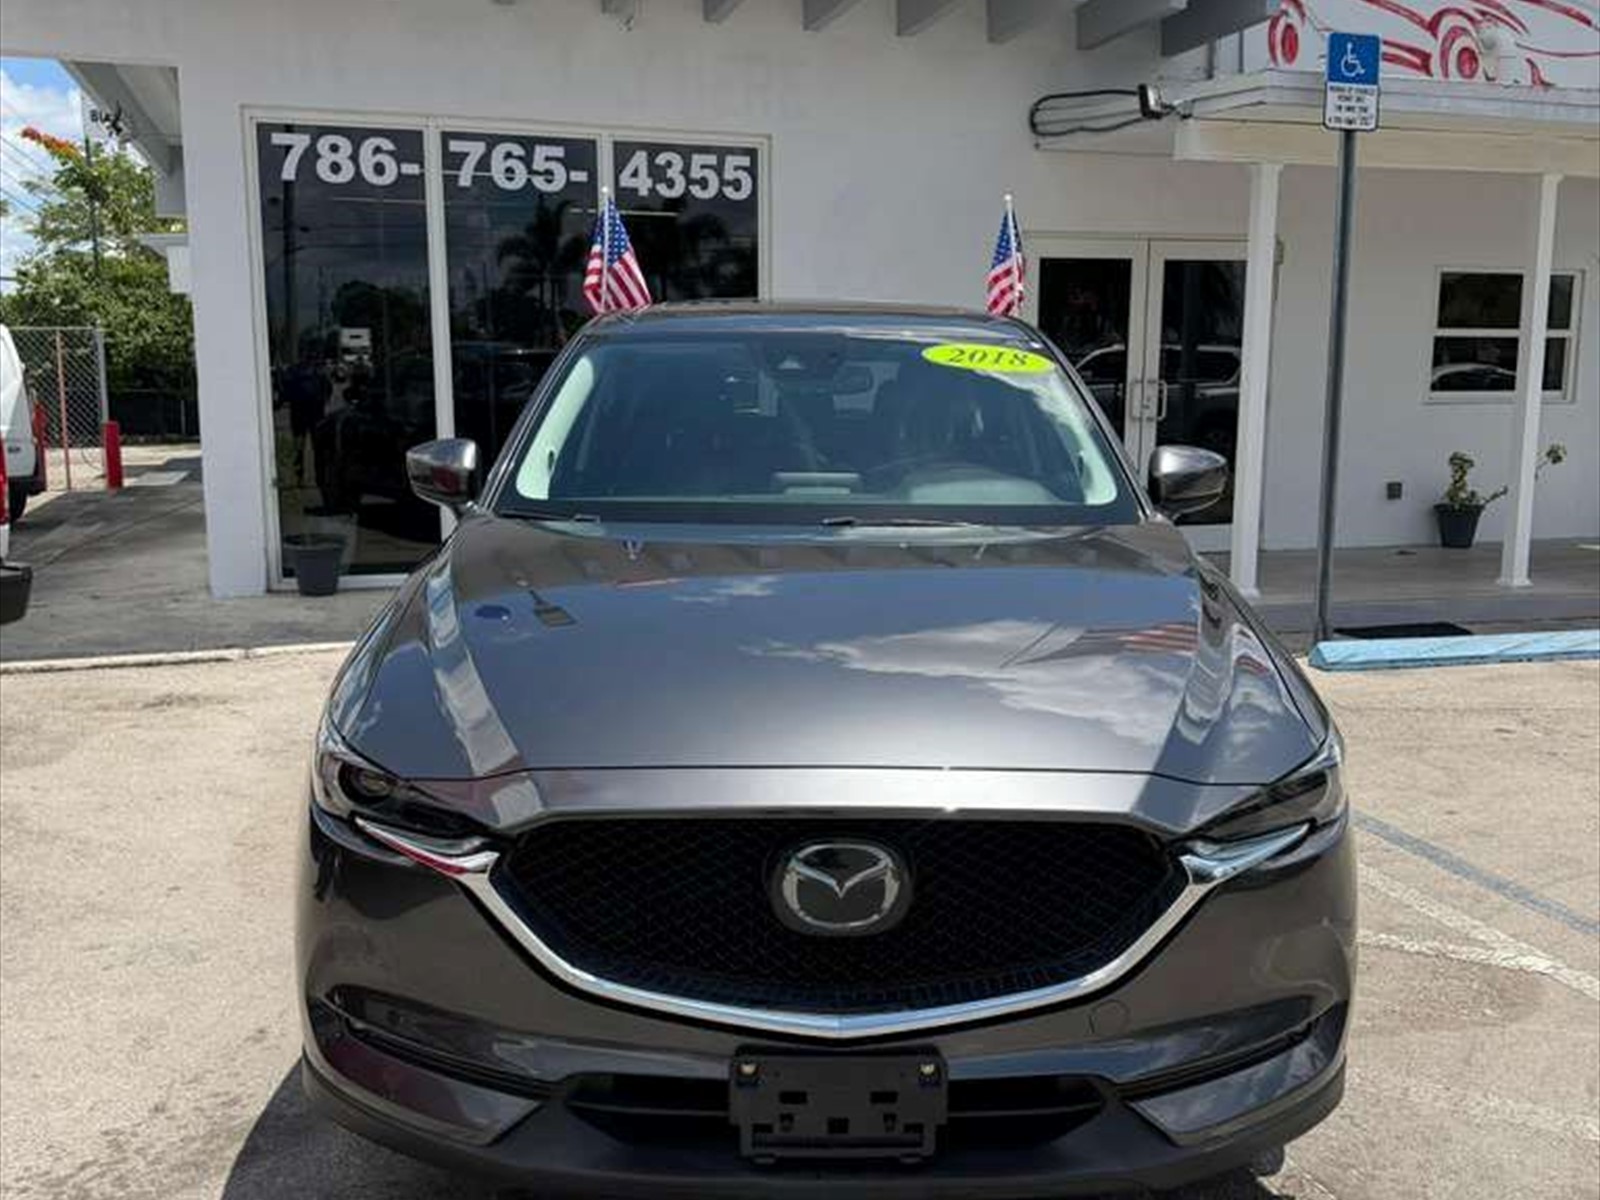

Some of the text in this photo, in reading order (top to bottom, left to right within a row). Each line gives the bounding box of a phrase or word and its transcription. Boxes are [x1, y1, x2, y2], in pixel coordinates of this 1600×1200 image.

[271, 132, 753, 201] 786- 765- 4355
[949, 347, 1029, 367] 2018
